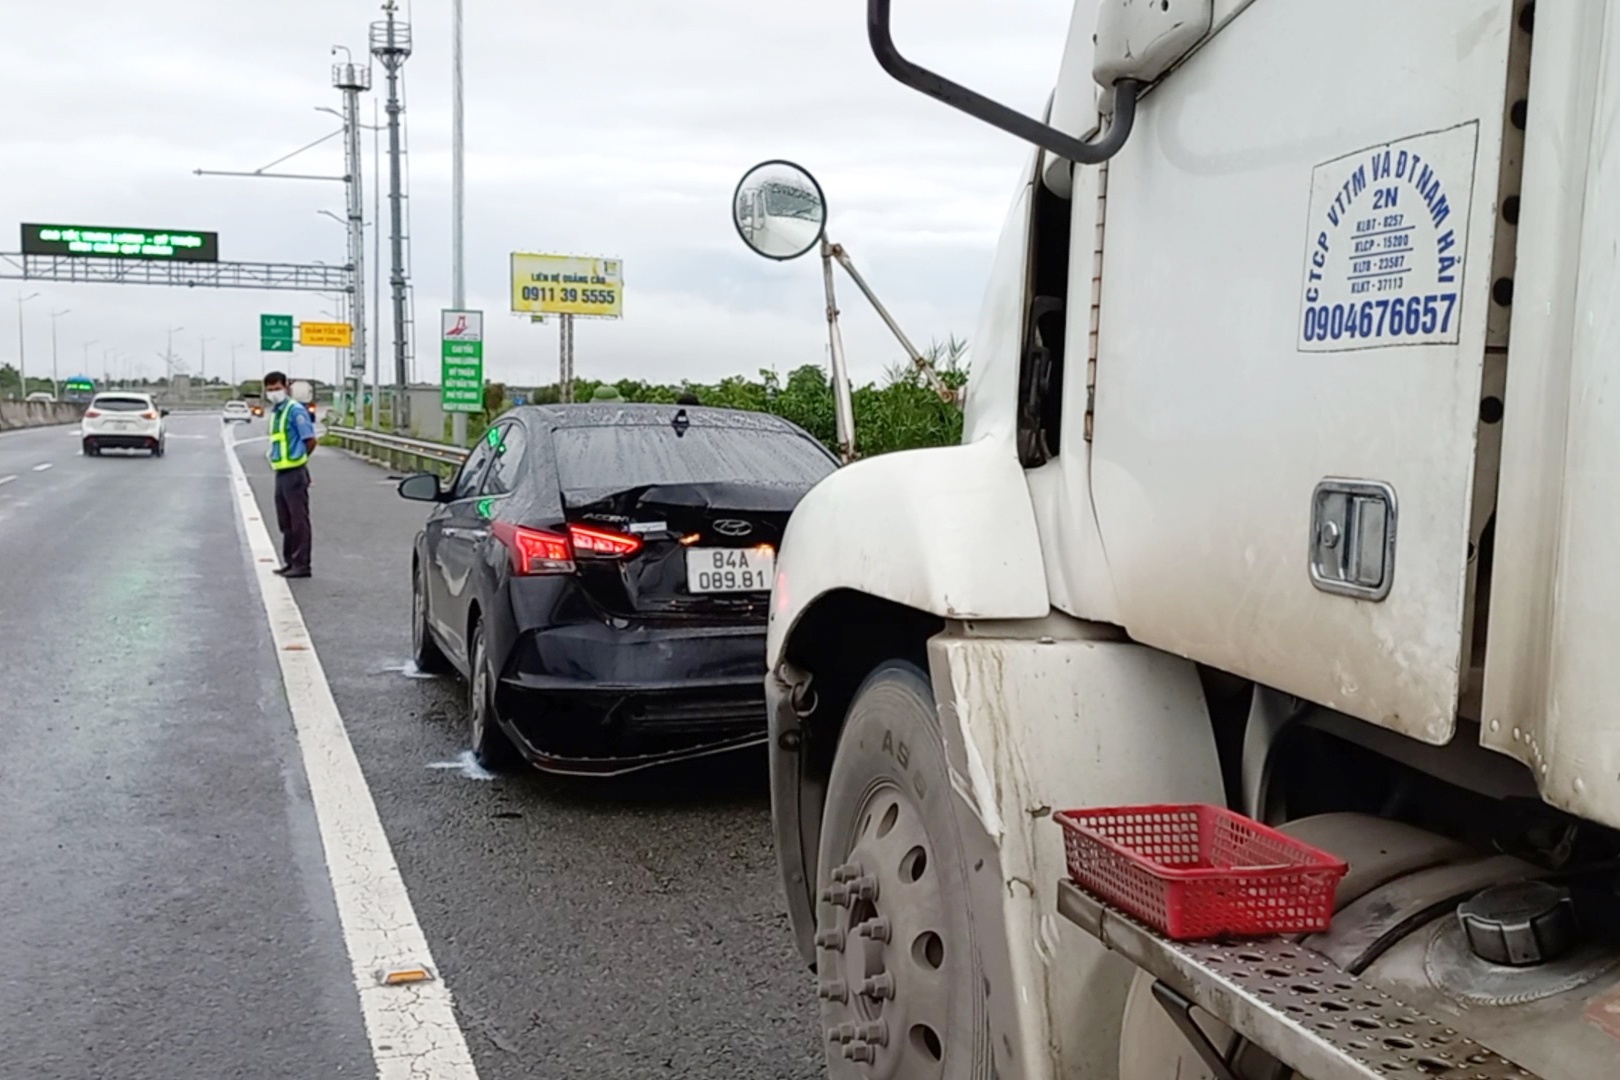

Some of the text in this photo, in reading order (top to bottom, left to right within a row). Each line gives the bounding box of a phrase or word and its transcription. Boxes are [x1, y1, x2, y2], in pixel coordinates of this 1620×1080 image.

[1327, 164, 1366, 227] VTTM
[1416, 163, 1451, 229] NAM
[1372, 186, 1399, 210] 2N
[1383, 234, 1409, 248] 15200
[1377, 277, 1404, 292] 37113
[522, 286, 615, 305] 0911 39 5555
[1303, 292, 1457, 342] 0904676657
[712, 551, 749, 569] 84A
[698, 570, 765, 590] 089.81
